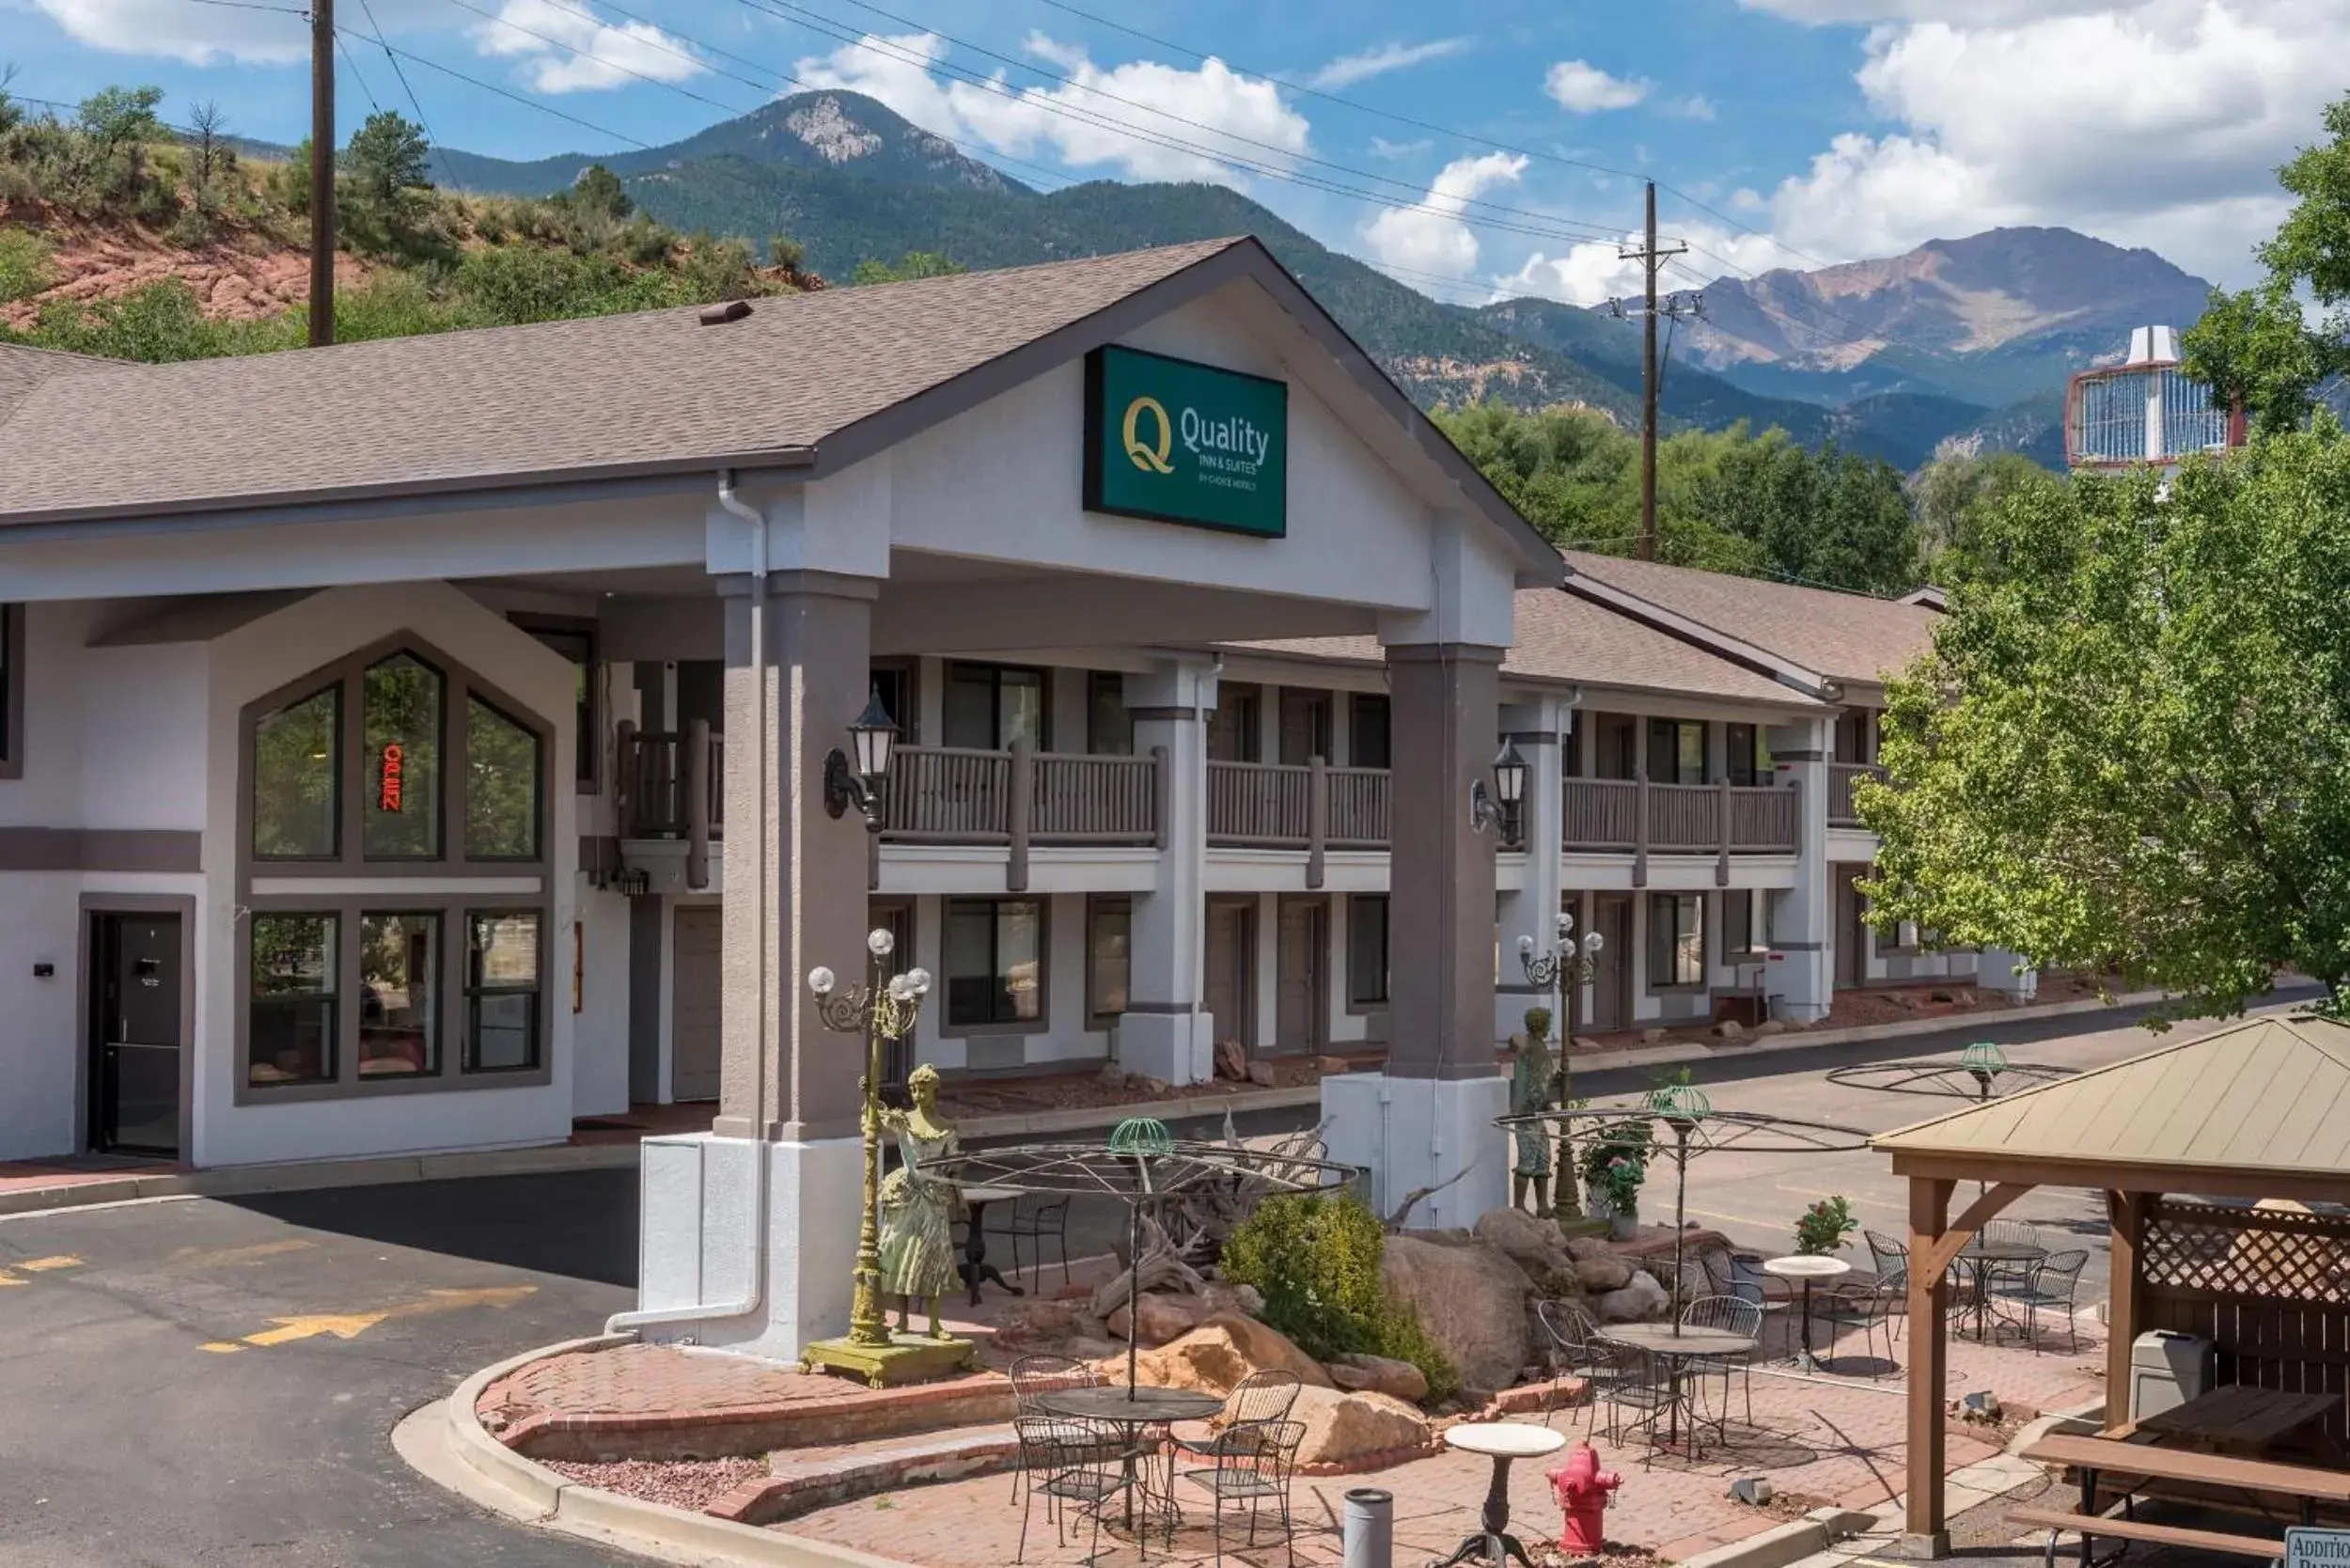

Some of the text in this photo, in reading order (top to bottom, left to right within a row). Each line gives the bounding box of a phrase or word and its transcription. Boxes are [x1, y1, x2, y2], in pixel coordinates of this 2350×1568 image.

[1123, 397, 1174, 475] Q
[1181, 406, 1269, 466] Quality
[1199, 453, 1257, 475] INN & SUITES
[384, 745, 402, 811] OPEN
